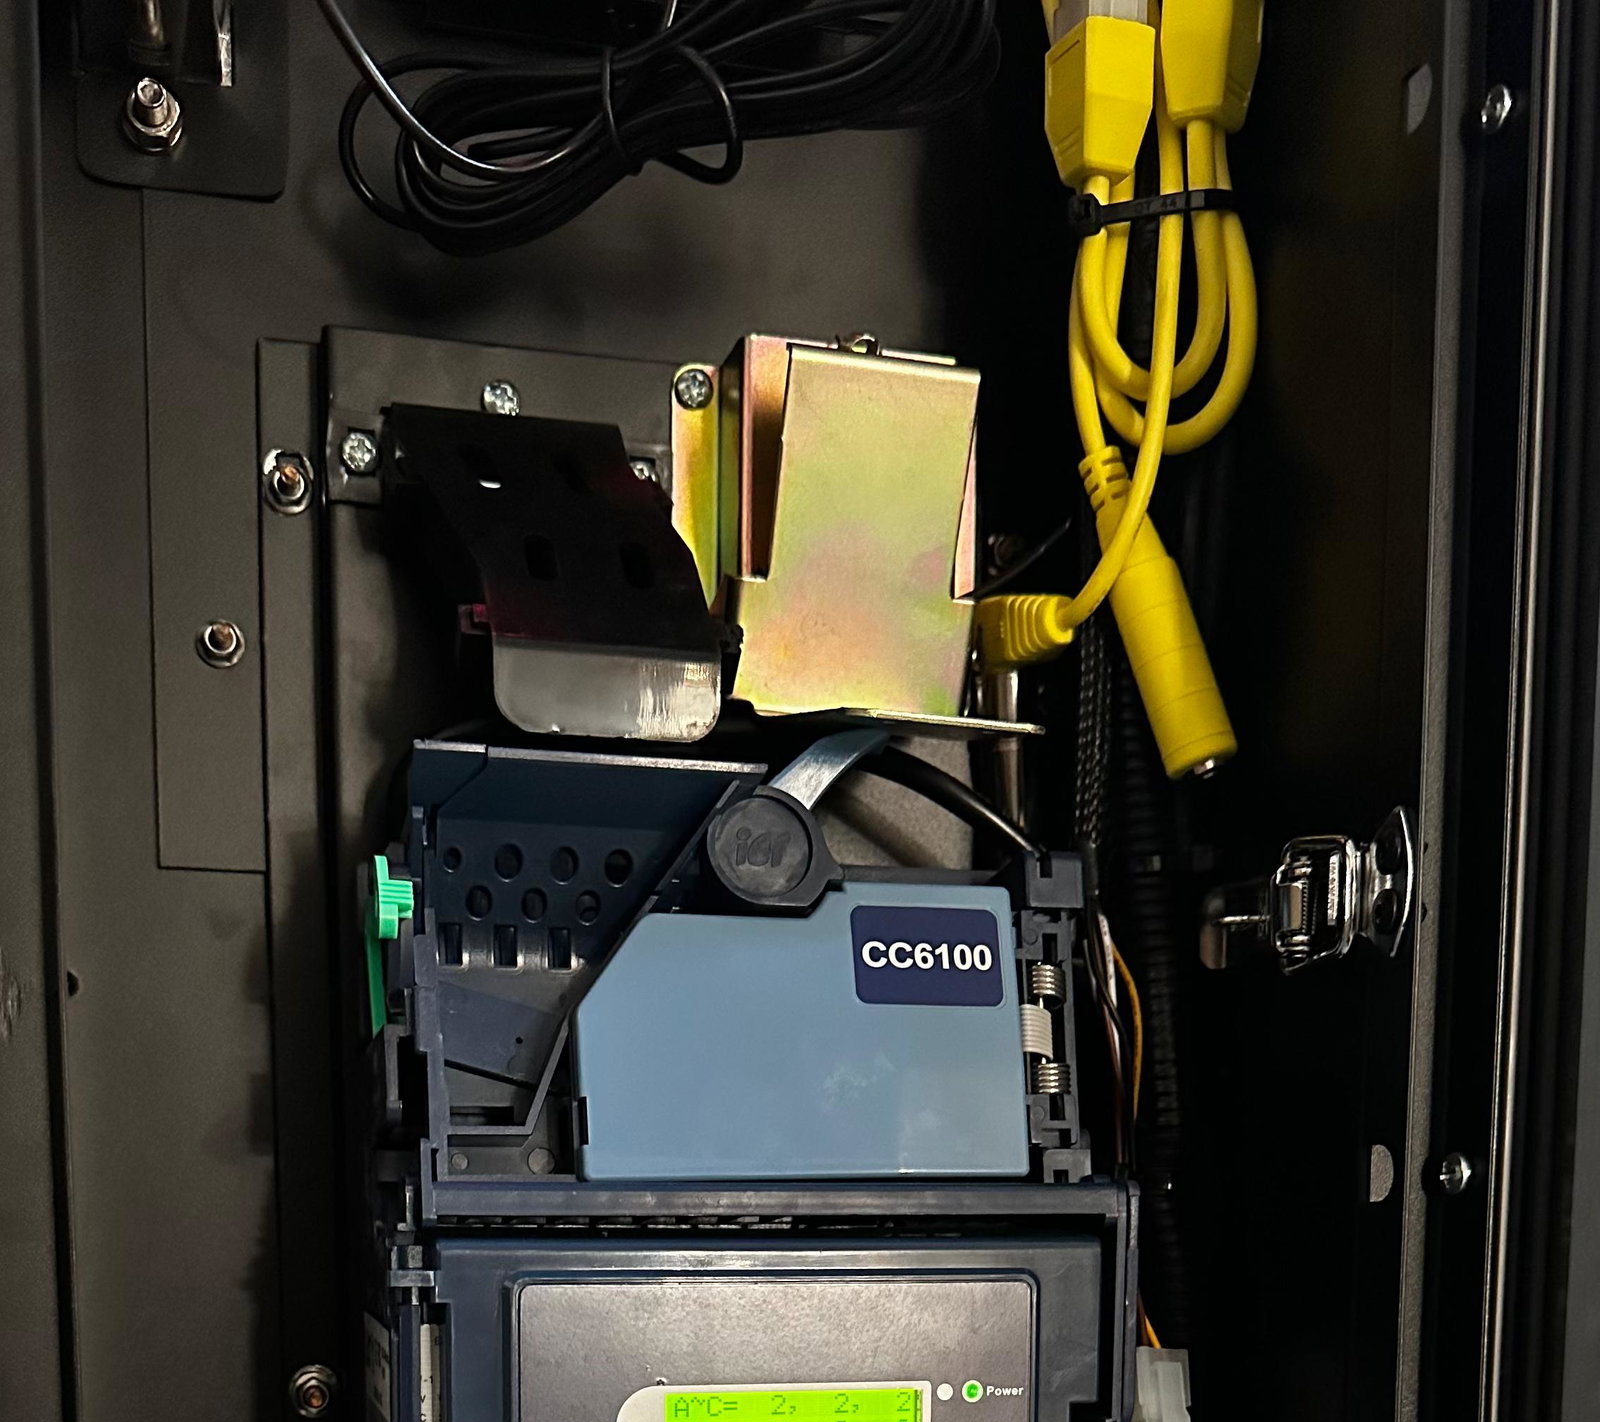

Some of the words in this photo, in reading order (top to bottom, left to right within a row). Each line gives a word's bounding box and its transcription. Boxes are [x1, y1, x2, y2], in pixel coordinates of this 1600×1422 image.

[861, 940, 992, 970] CC6100
[986, 1385, 1024, 1397] Power
[896, 1392, 911, 1412] 2
